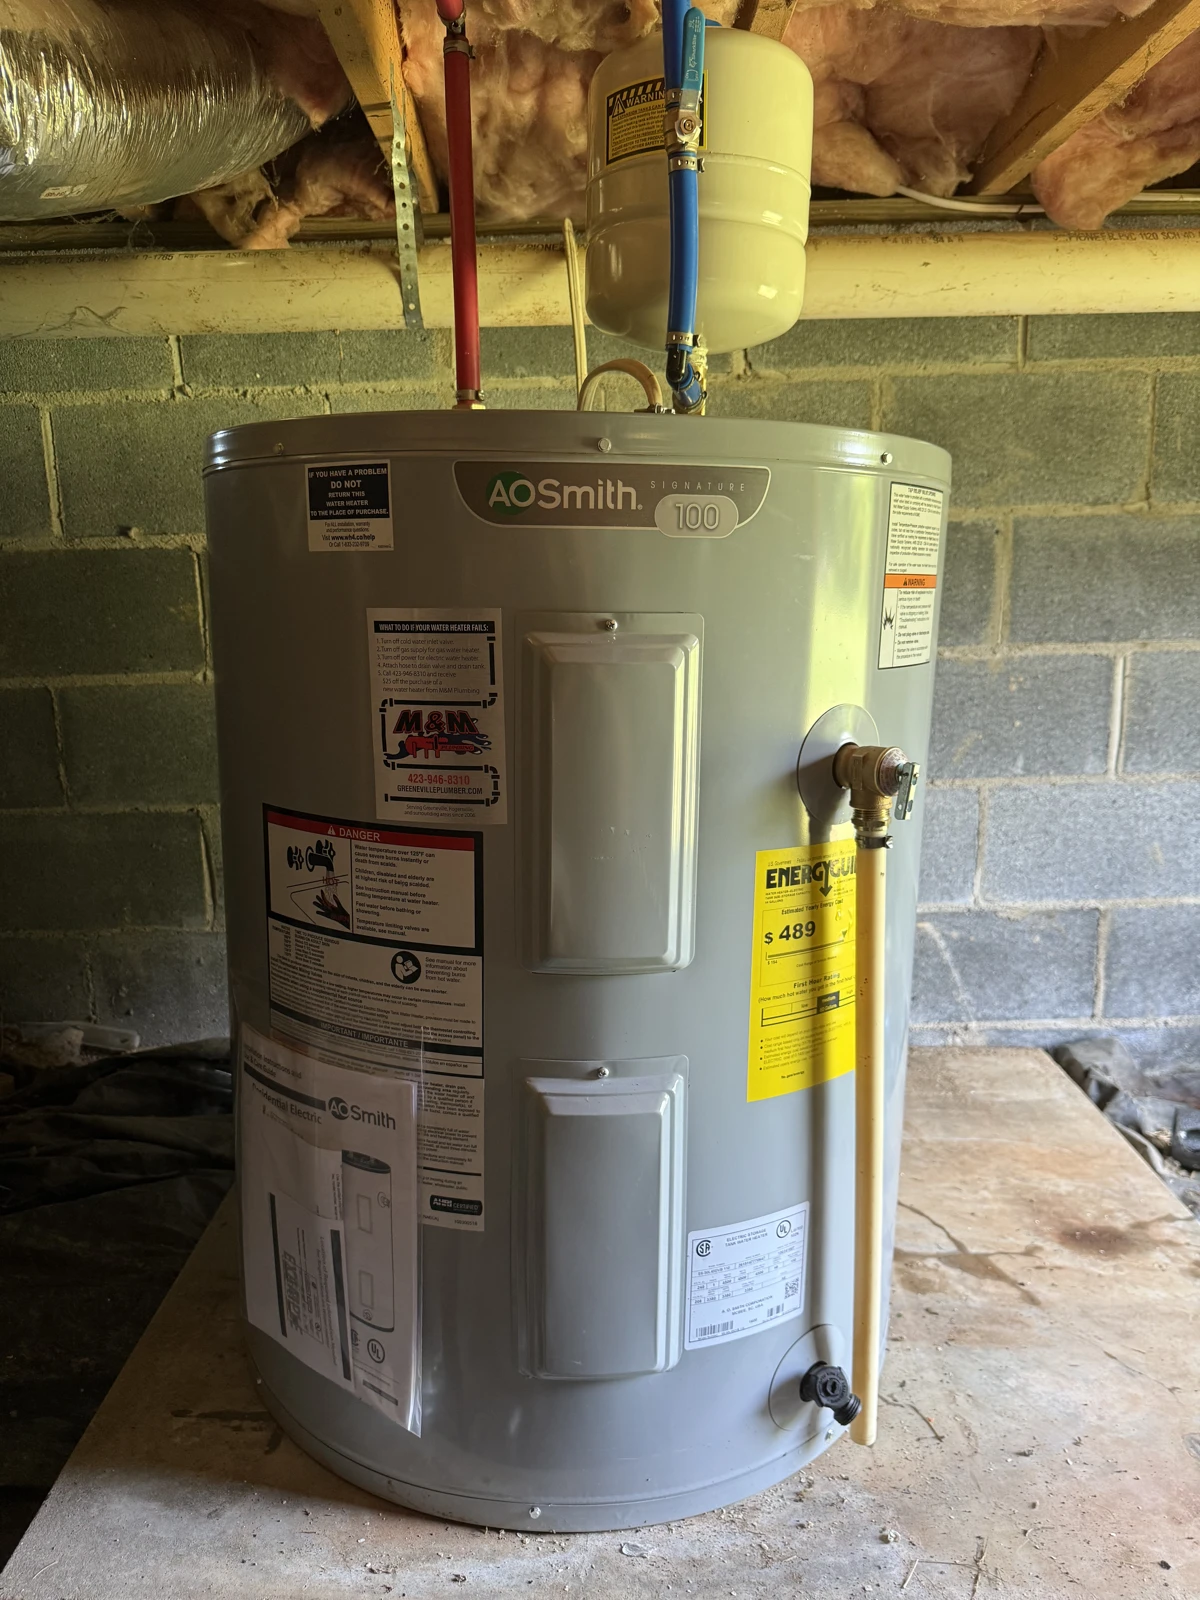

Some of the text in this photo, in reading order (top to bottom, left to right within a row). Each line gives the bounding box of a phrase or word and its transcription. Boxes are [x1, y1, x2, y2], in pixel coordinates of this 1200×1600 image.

[626, 90, 665, 107] WARNIN
[1162, 232, 1180, 240] SCH
[354, 468, 387, 476] PROBLEM
[344, 480, 362, 488] NOT
[650, 480, 745, 492] SIGNATURE
[489, 478, 636, 510] AOSmith
[676, 503, 720, 530] 100
[393, 710, 479, 734] M&M
[408, 774, 470, 785] 423-946-8310
[397, 785, 482, 794] GREENEVILLEPLUMBER.COM
[339, 828, 380, 842] DANGER
[368, 846, 396, 855] temperature
[766, 855, 856, 891] ENERGYGUI
[356, 908, 380, 916] showering.
[782, 907, 804, 915] Estimated
[806, 904, 819, 912] Yearly
[356, 918, 384, 927] Temperature
[764, 921, 816, 945] $ 489
[794, 973, 840, 988] First Hour Rating
[320, 1023, 356, 1037] IMPORTANT
[361, 1034, 408, 1048] IMPORTANTE
[290, 1102, 322, 1124] Electric
[328, 1096, 395, 1130] AOSmith
[748, 1229, 766, 1238] STORAGE
